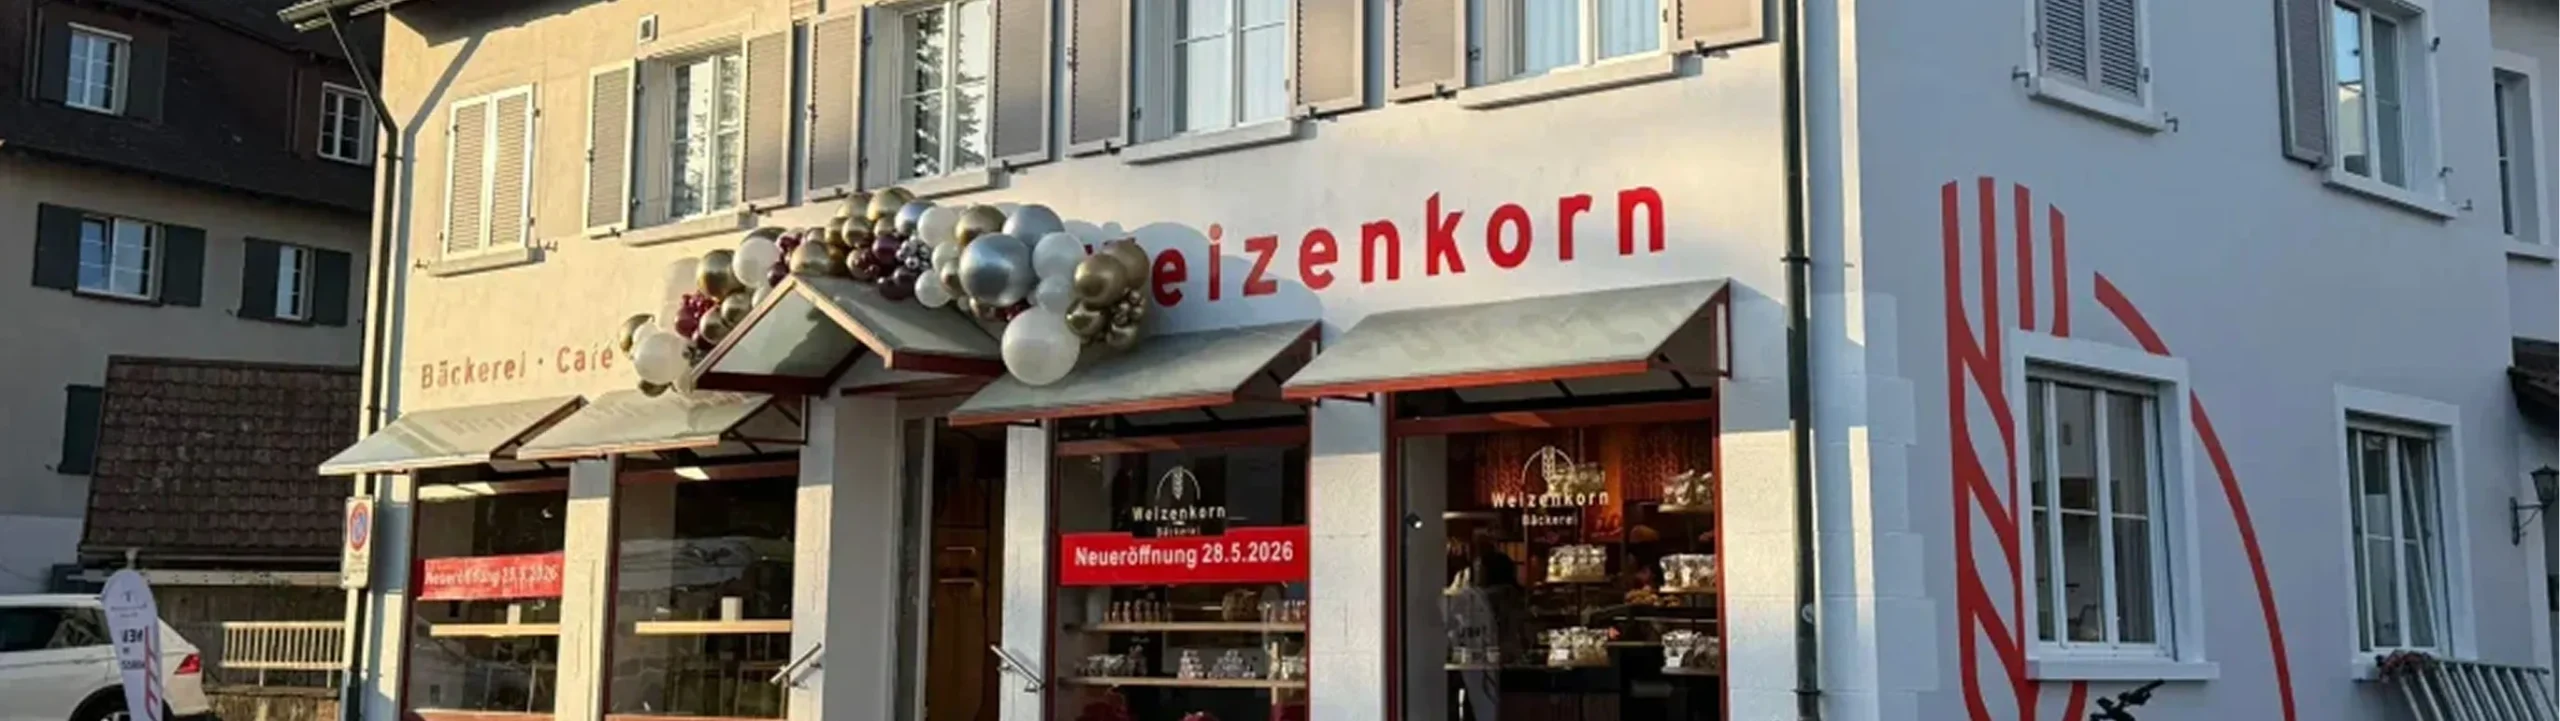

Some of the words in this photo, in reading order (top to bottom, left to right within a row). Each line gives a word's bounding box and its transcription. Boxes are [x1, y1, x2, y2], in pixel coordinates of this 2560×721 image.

[1084, 186, 1664, 307] eizenkorn
[421, 351, 526, 389] Bäckerei
[556, 340, 613, 373] Café
[1131, 505, 1226, 522] Weizenkorn
[1491, 491, 1609, 509] Weizenkorn
[1075, 545, 1197, 569] Neueröffnung
[1202, 540, 1294, 563] 28.5.2026
